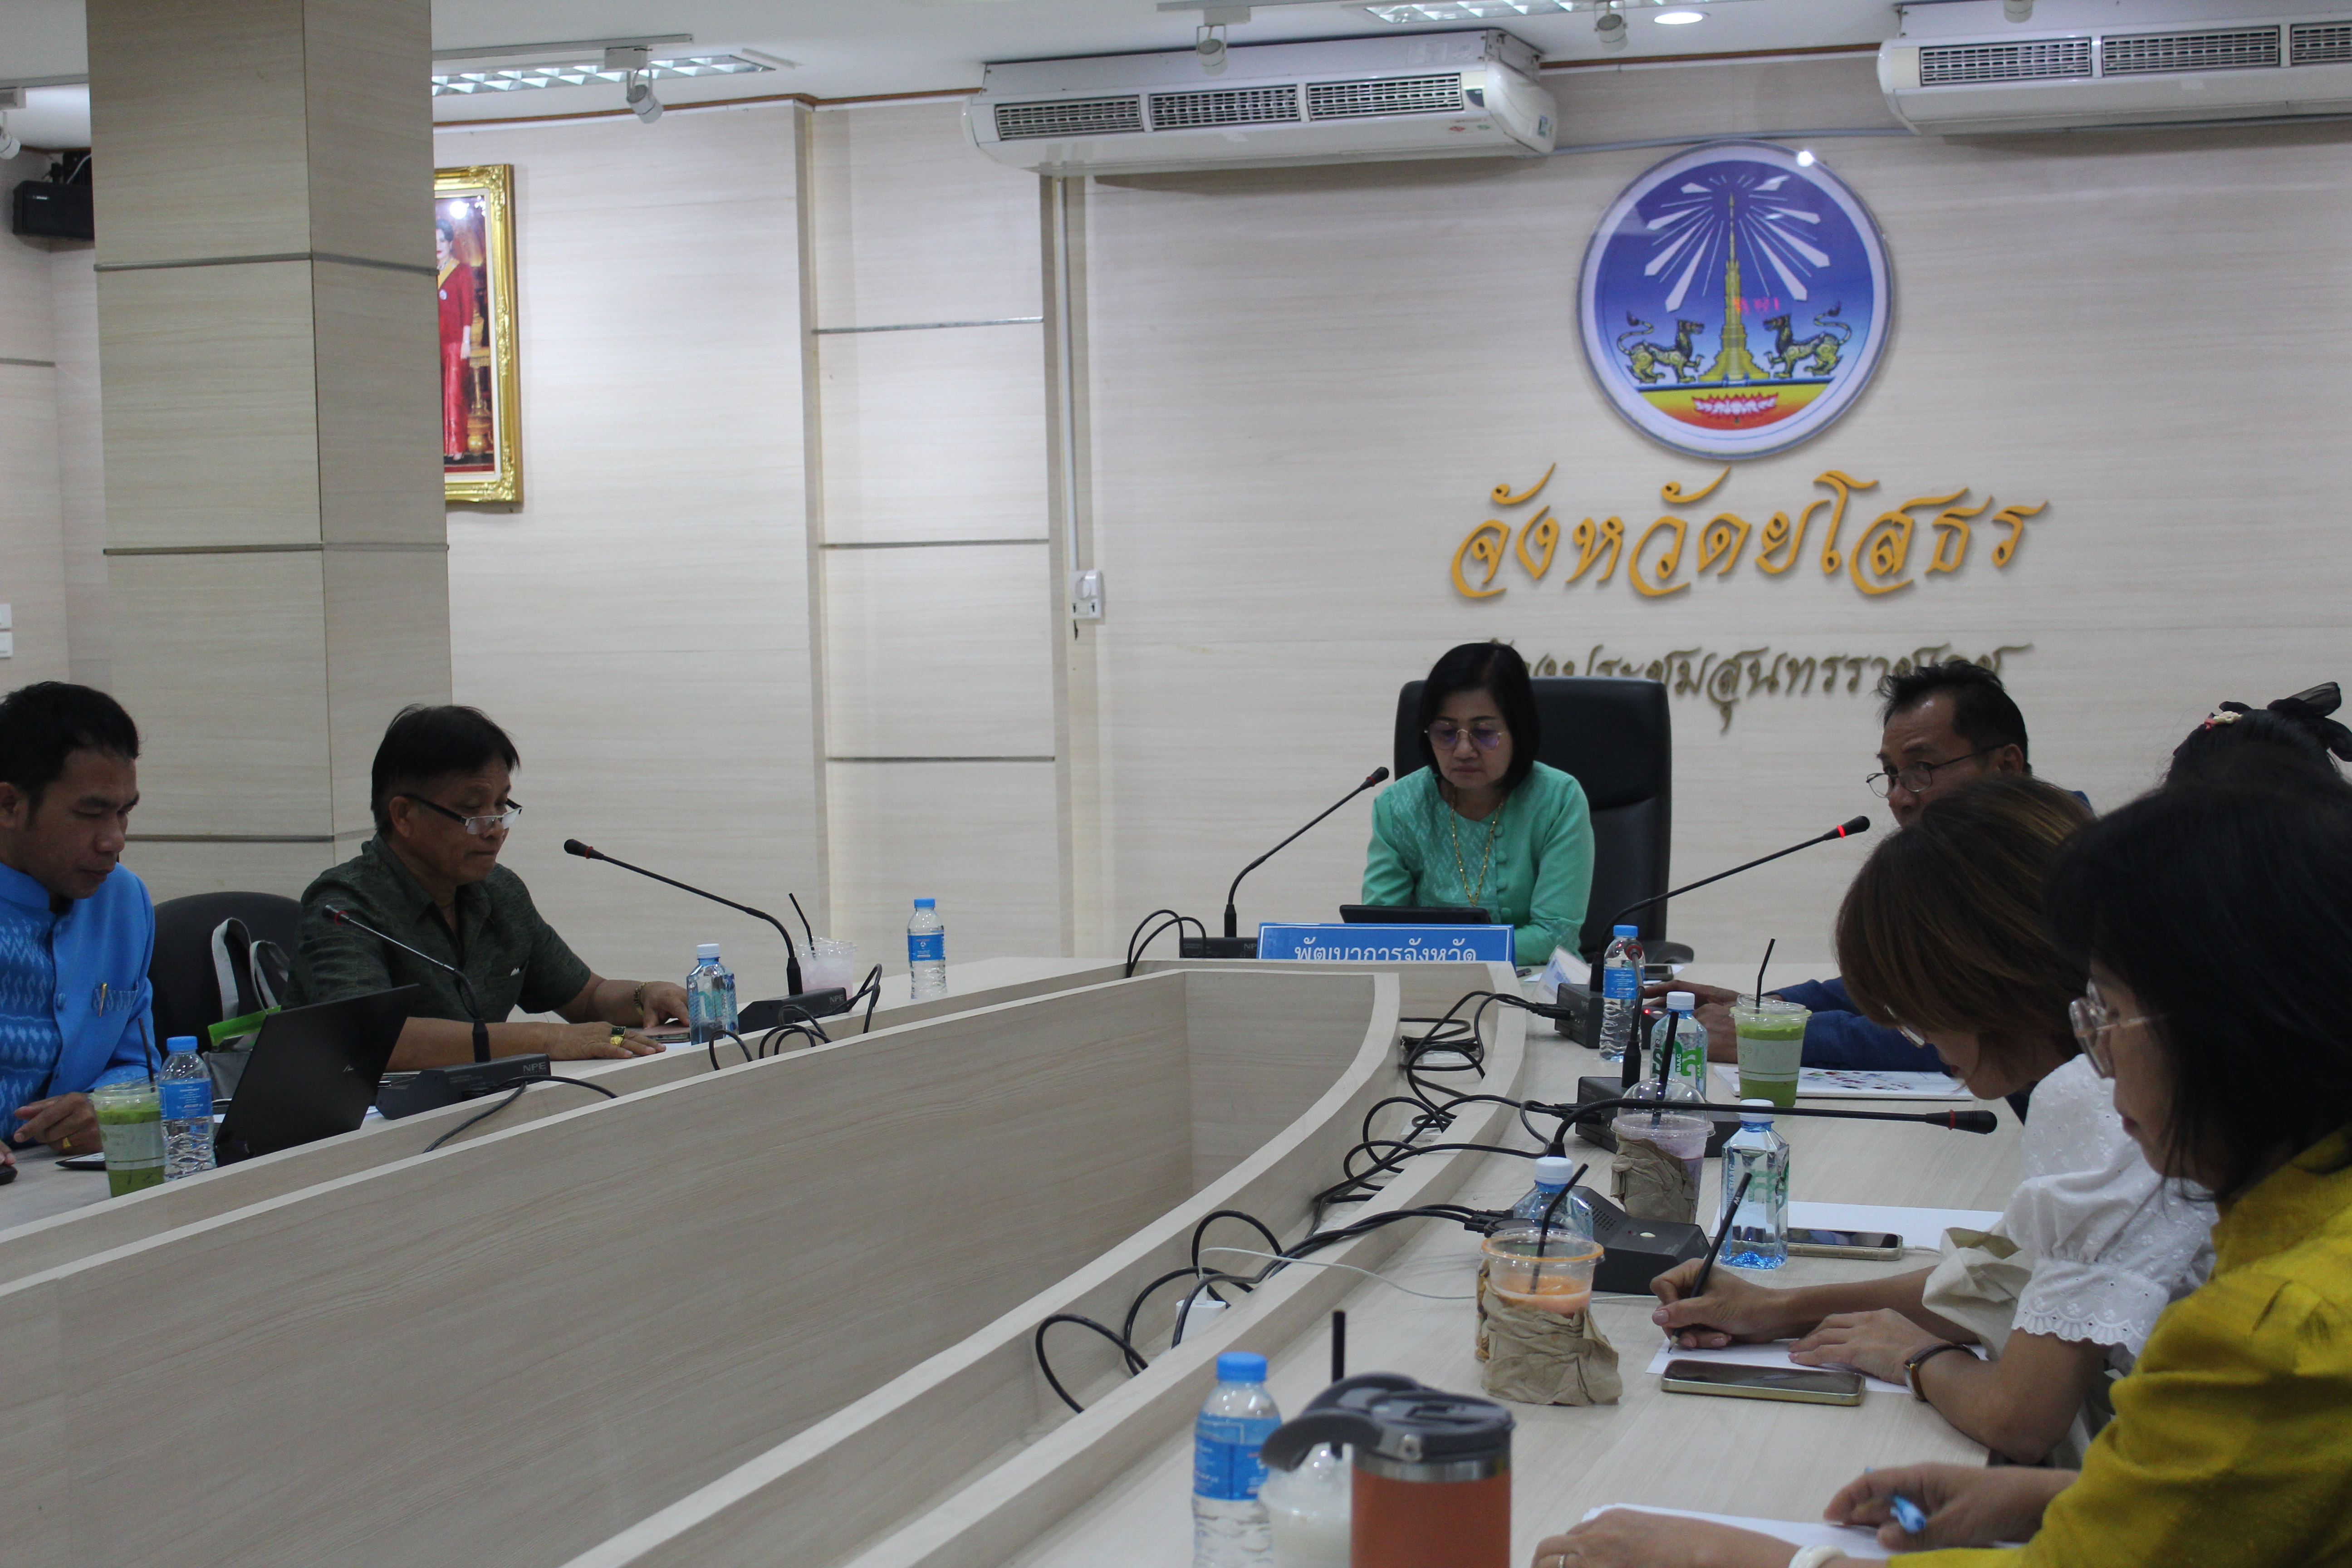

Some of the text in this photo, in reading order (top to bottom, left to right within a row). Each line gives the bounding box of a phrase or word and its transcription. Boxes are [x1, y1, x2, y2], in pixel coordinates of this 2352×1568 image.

[1451, 464, 2046, 598] จังหวัดยโสธร
[830, 995, 844, 1003] NPE
[523, 1062, 546, 1072] NPE
